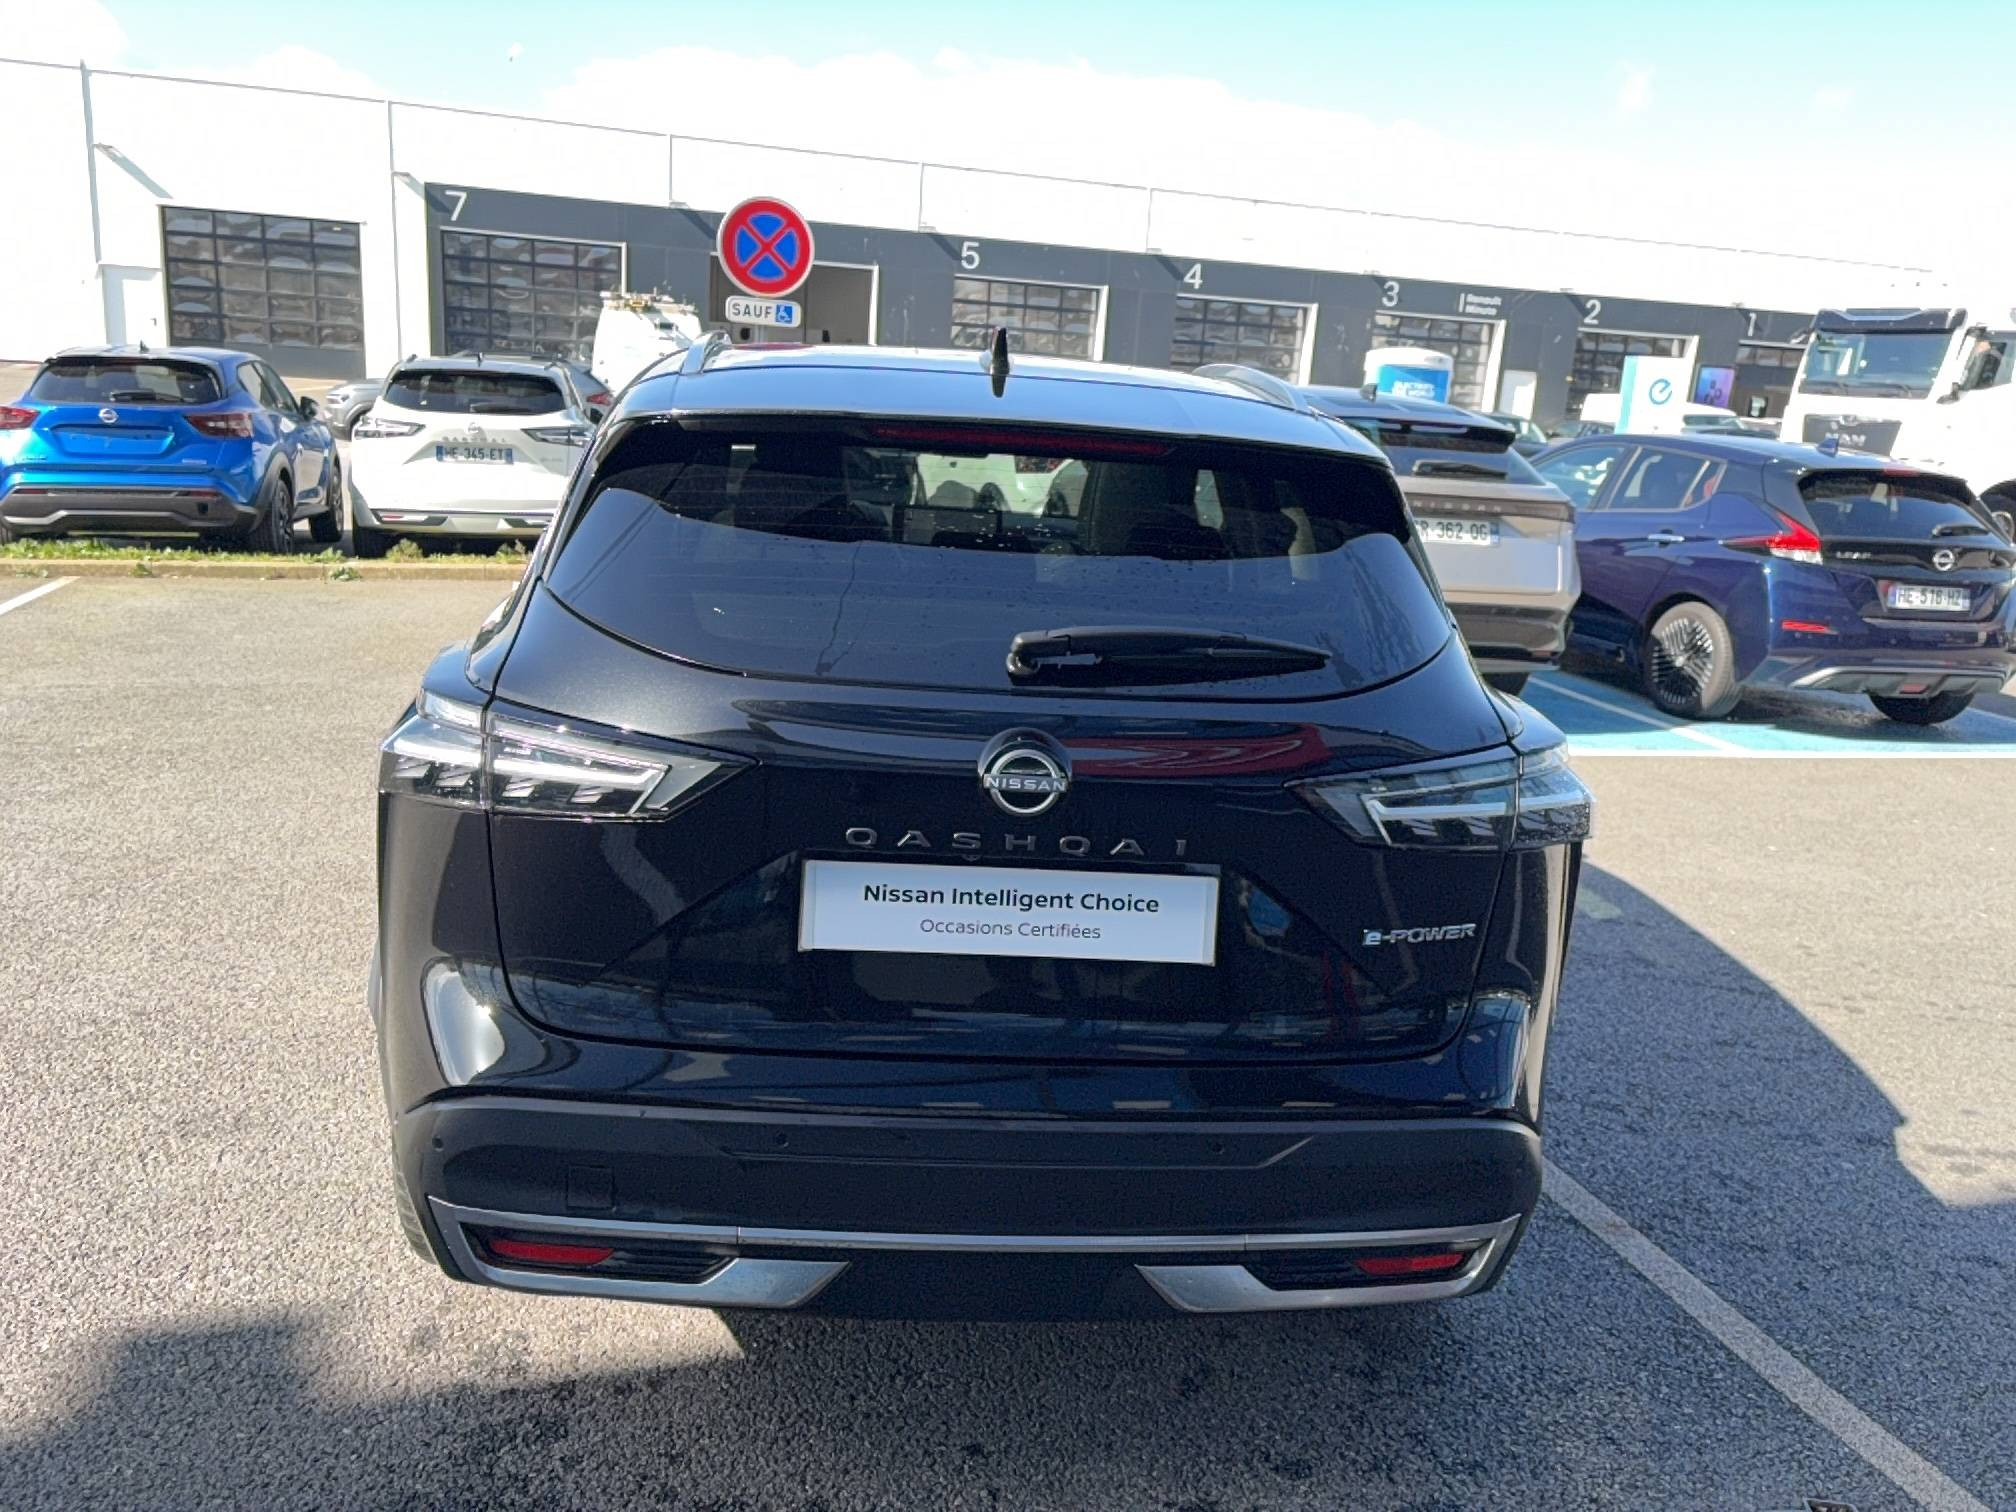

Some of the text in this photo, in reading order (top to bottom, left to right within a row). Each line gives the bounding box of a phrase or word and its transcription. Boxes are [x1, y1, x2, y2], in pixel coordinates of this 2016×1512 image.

[445, 191, 467, 221] 7
[960, 241, 980, 269] 5
[1183, 263, 1203, 289] 4
[1381, 281, 1399, 307] 3
[731, 302, 774, 319] SAUF
[1583, 299, 1601, 325] 2
[1747, 312, 1757, 337] 1
[986, 774, 1066, 793] NISSAN
[844, 825, 1189, 857] QASHQAI
[864, 884, 1160, 914] Nissan Intelligent Choice
[920, 918, 1101, 940] Occasions Certifiées
